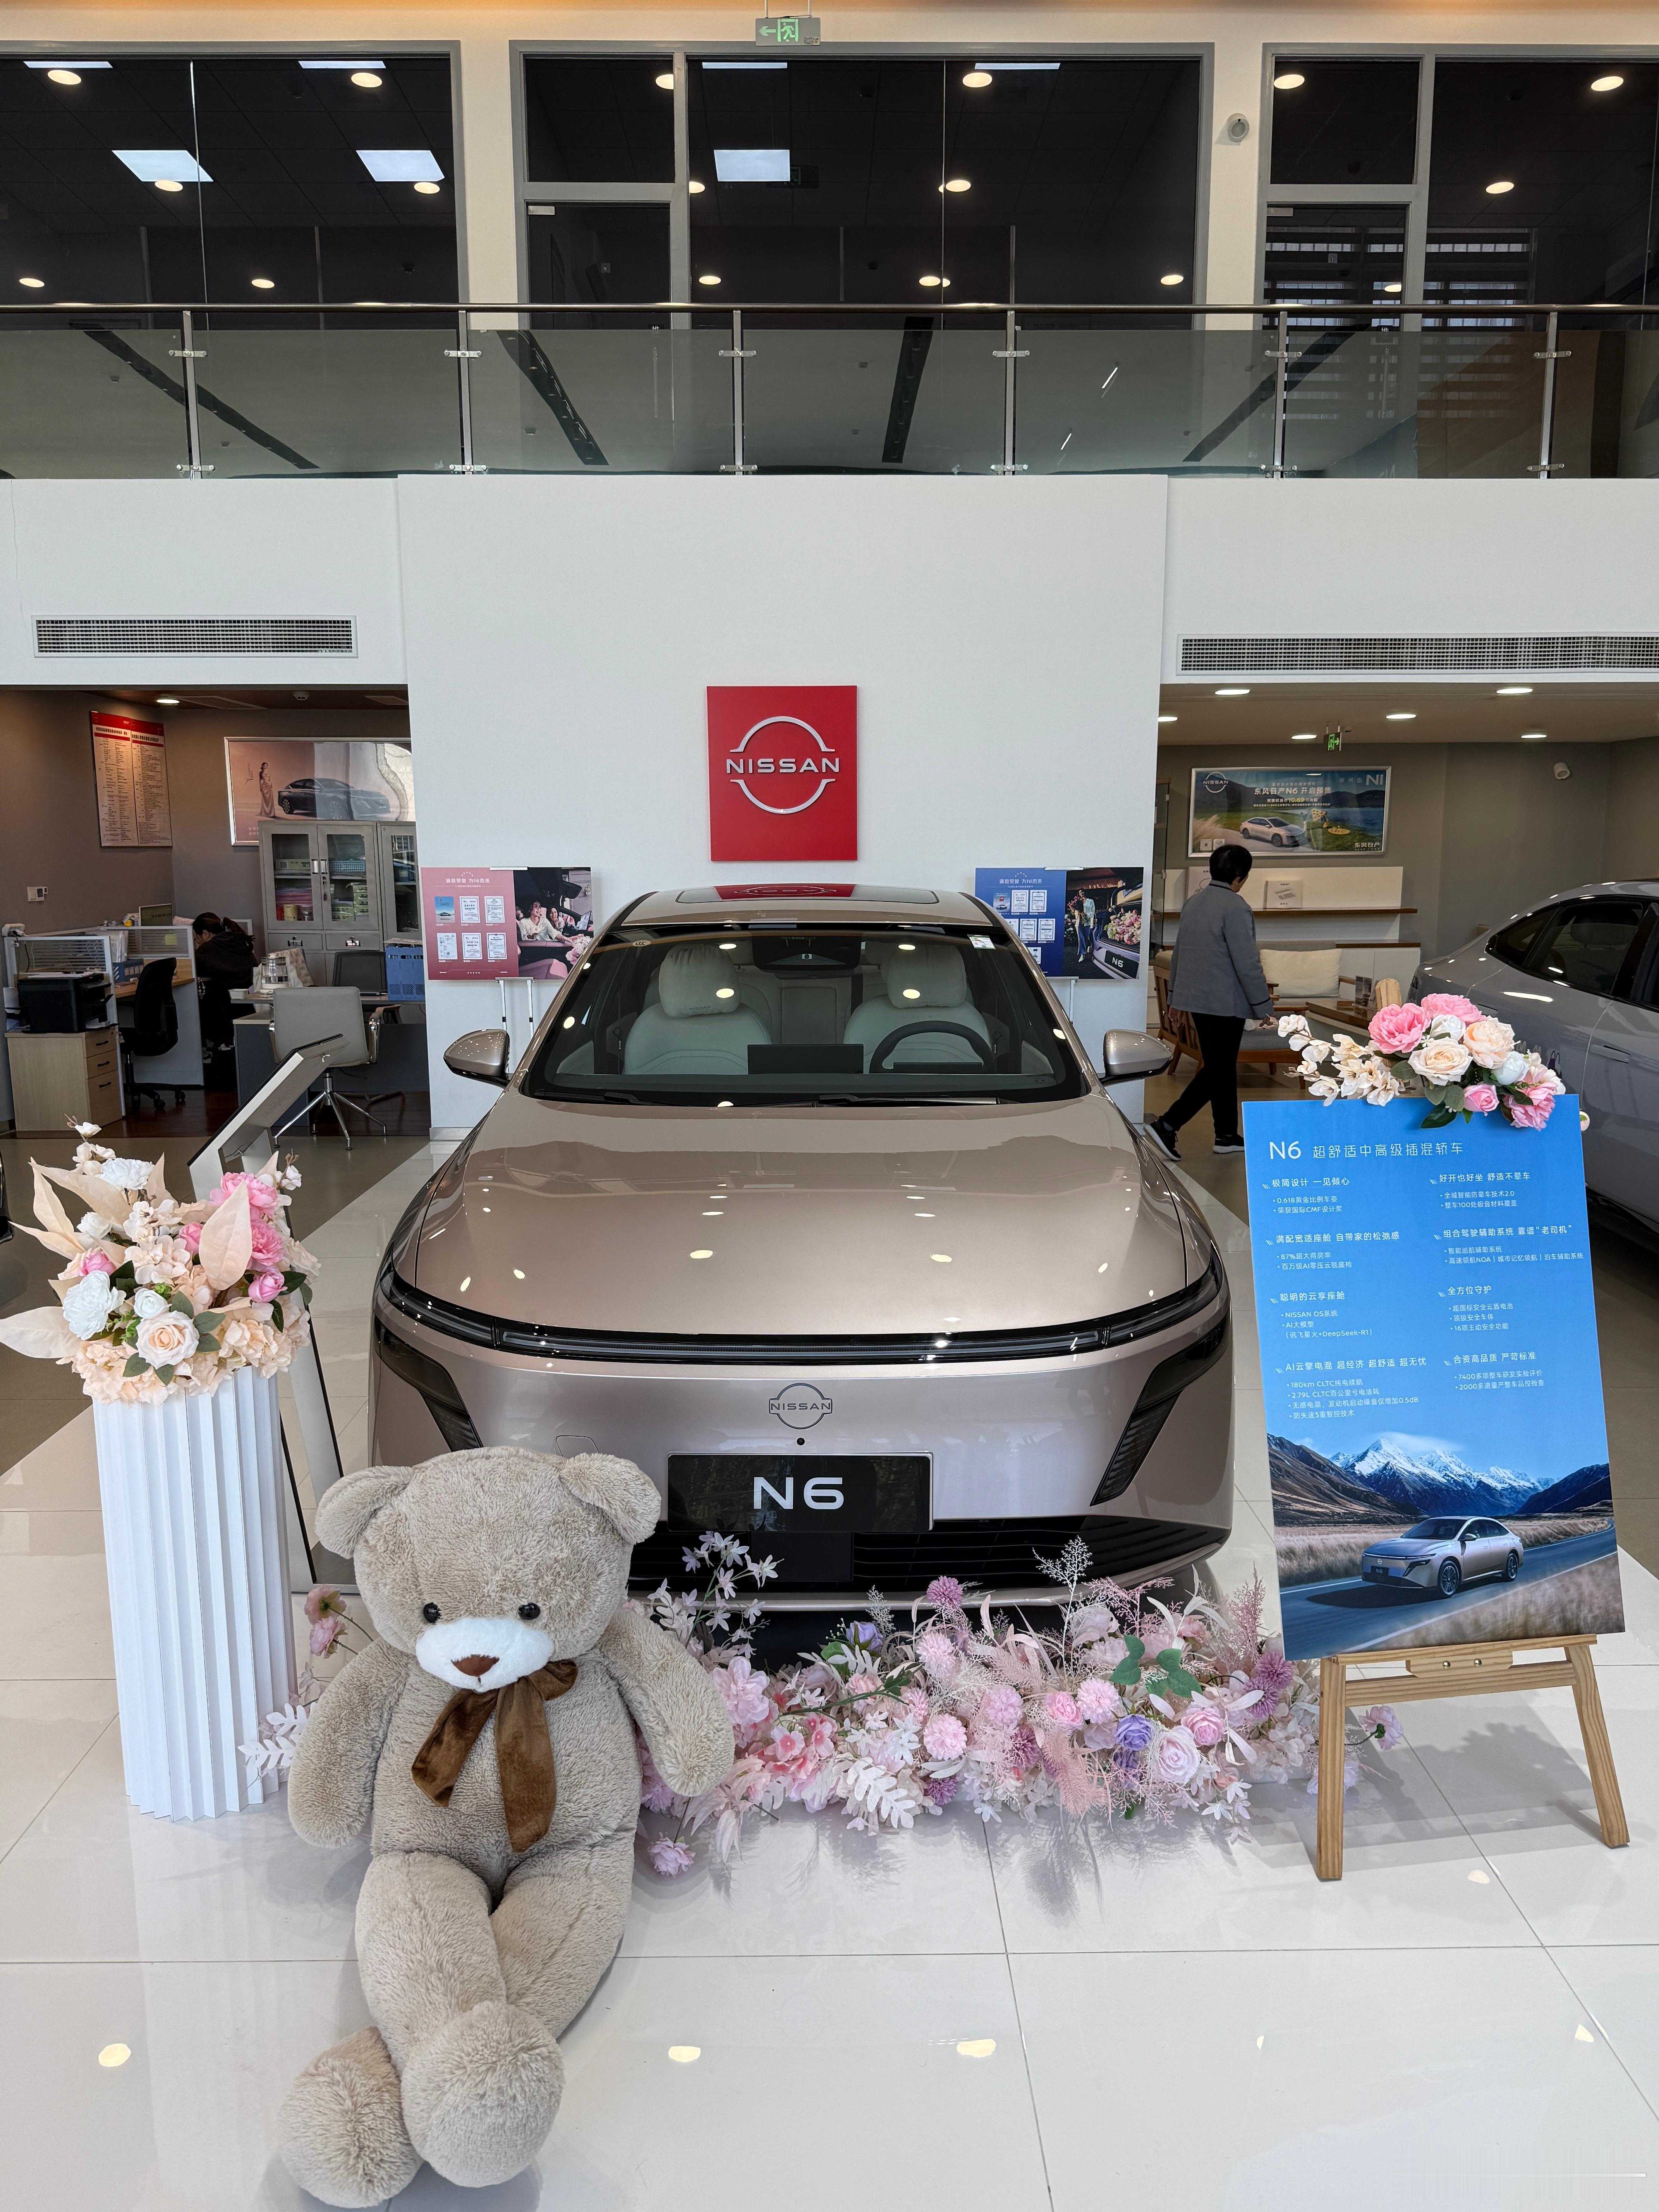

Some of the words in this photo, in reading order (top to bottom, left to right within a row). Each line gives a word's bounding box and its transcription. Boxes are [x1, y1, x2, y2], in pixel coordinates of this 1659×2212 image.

[726, 758, 839, 773] NISSAN
[1366, 775, 1383, 785] NI
[1112, 957, 1123, 968] N6
[1269, 1141, 1301, 1159] N6
[1313, 1142, 1463, 1158] 超舒适中高级插混轿车
[1439, 1174, 1483, 1182] 好开也好坐
[1487, 1172, 1530, 1181] 舒适不晕车
[1272, 1178, 1309, 1187] 极简设计
[1313, 1178, 1349, 1186] 一见倾心
[1445, 1200, 1517, 1208] 整车100处吸音材料覆盖
[1276, 1234, 1331, 1243] 满配宽适座舱
[1336, 1231, 1399, 1241] 自带家的松弛感
[1443, 1228, 1513, 1238] 组合驾驶辅助系统
[1498, 1254, 1537, 1262] 城市记忆领航
[1544, 1252, 1583, 1261] 泊车辅助系统
[1448, 1285, 1491, 1295] 全方位守护
[1280, 1291, 1345, 1301] 聪明的云享座舱
[1453, 1303, 1513, 1312] 超国标安全云盾电池
[1455, 1322, 1509, 1331] 16项主动安全功能
[1453, 1353, 1498, 1364] 合资高品质
[1501, 1352, 1536, 1362] 严苛标准
[1286, 1361, 1332, 1371] AI云擎电混
[1337, 1360, 1364, 1369] 超经济
[1368, 1358, 1395, 1368] 超舒适
[1400, 1357, 1426, 1366] 超无忧
[1458, 1370, 1542, 1380] 7400多项整车研发实验评价
[1317, 1379, 1363, 1387] CLTC纯电续航
[1460, 1380, 1544, 1390] 2000多道量产整车品控检查
[1312, 1388, 1379, 1398] CLTC百公里亏电油耗
[1293, 1410, 1355, 1419] 防失速3重智控技术
[754, 1477, 844, 1510] N6
